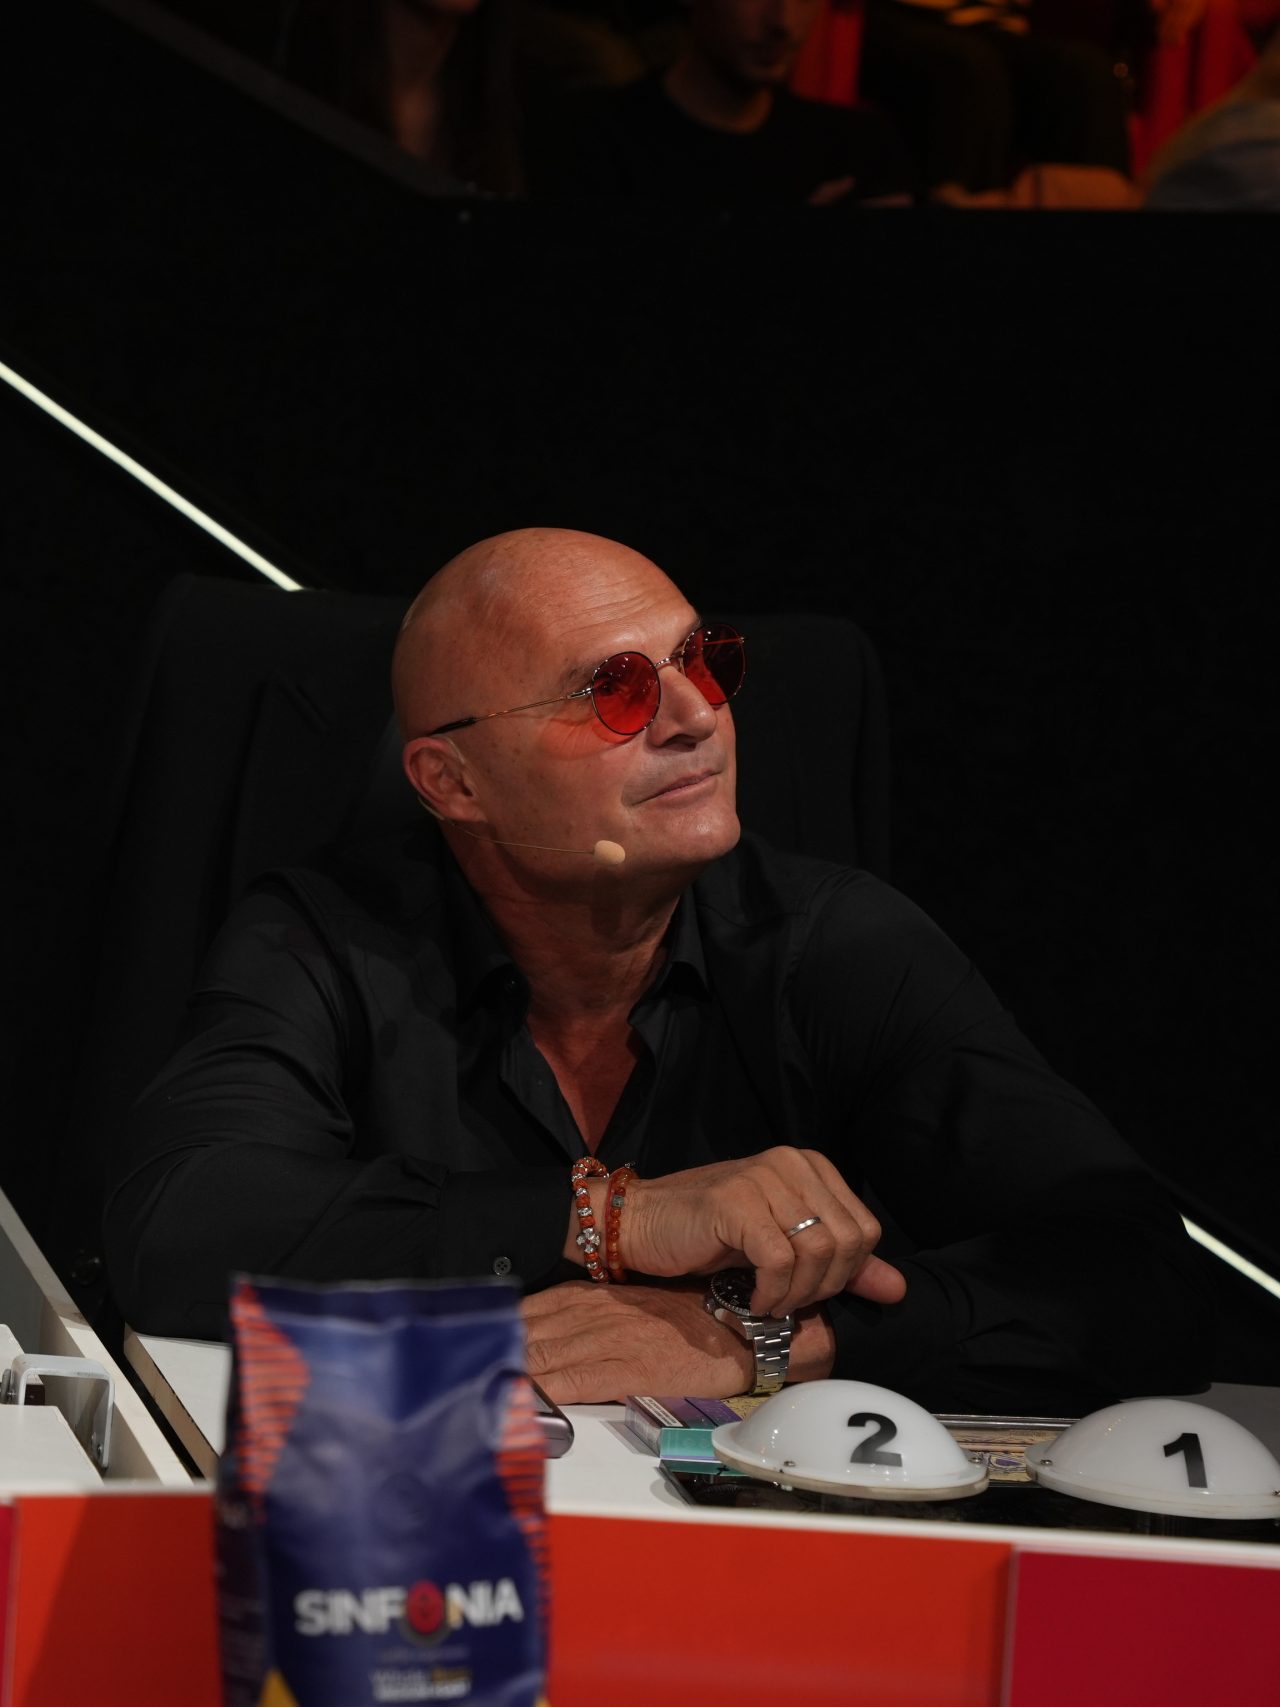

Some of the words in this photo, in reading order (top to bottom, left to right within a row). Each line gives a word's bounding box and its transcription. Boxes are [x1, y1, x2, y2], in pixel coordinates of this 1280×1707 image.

[847, 1411, 904, 1468] 2
[1162, 1431, 1209, 1489] 1
[294, 1576, 524, 1638] SINFONIA
